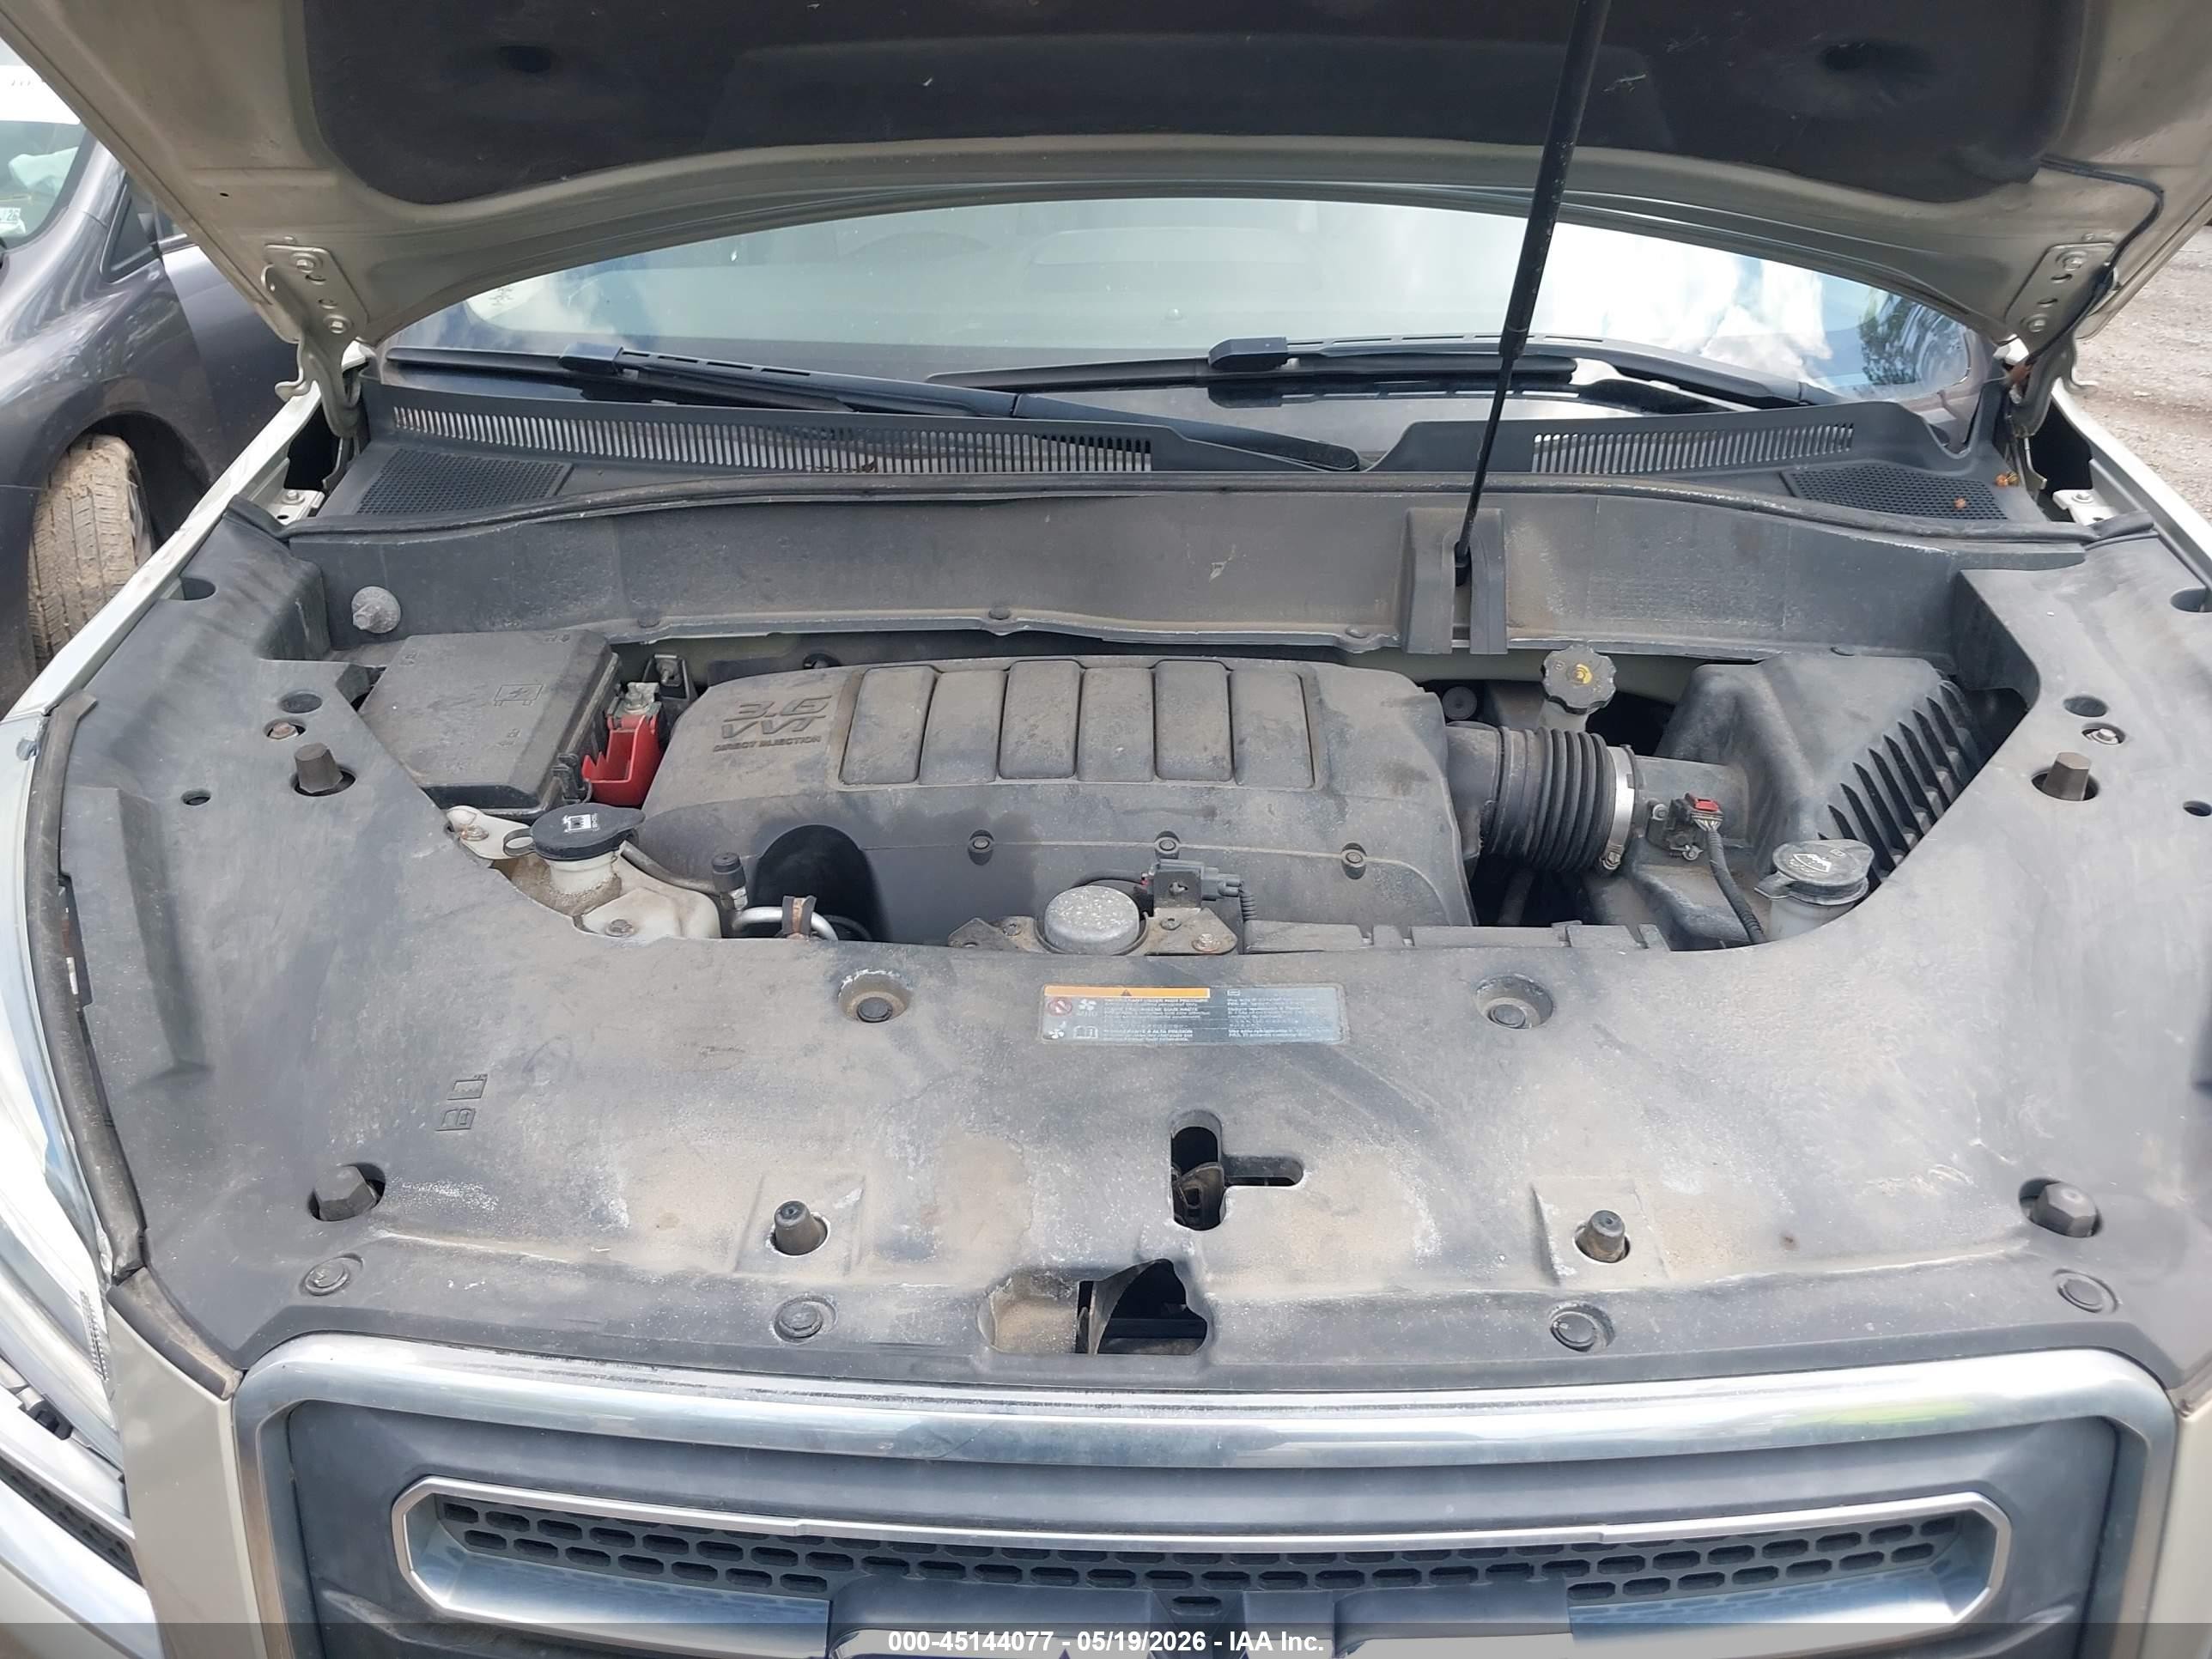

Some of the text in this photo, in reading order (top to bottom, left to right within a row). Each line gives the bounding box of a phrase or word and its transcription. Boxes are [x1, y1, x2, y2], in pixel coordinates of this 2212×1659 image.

[723, 694, 832, 723] 3.6
[713, 736, 822, 752] DIRECT INJECTION
